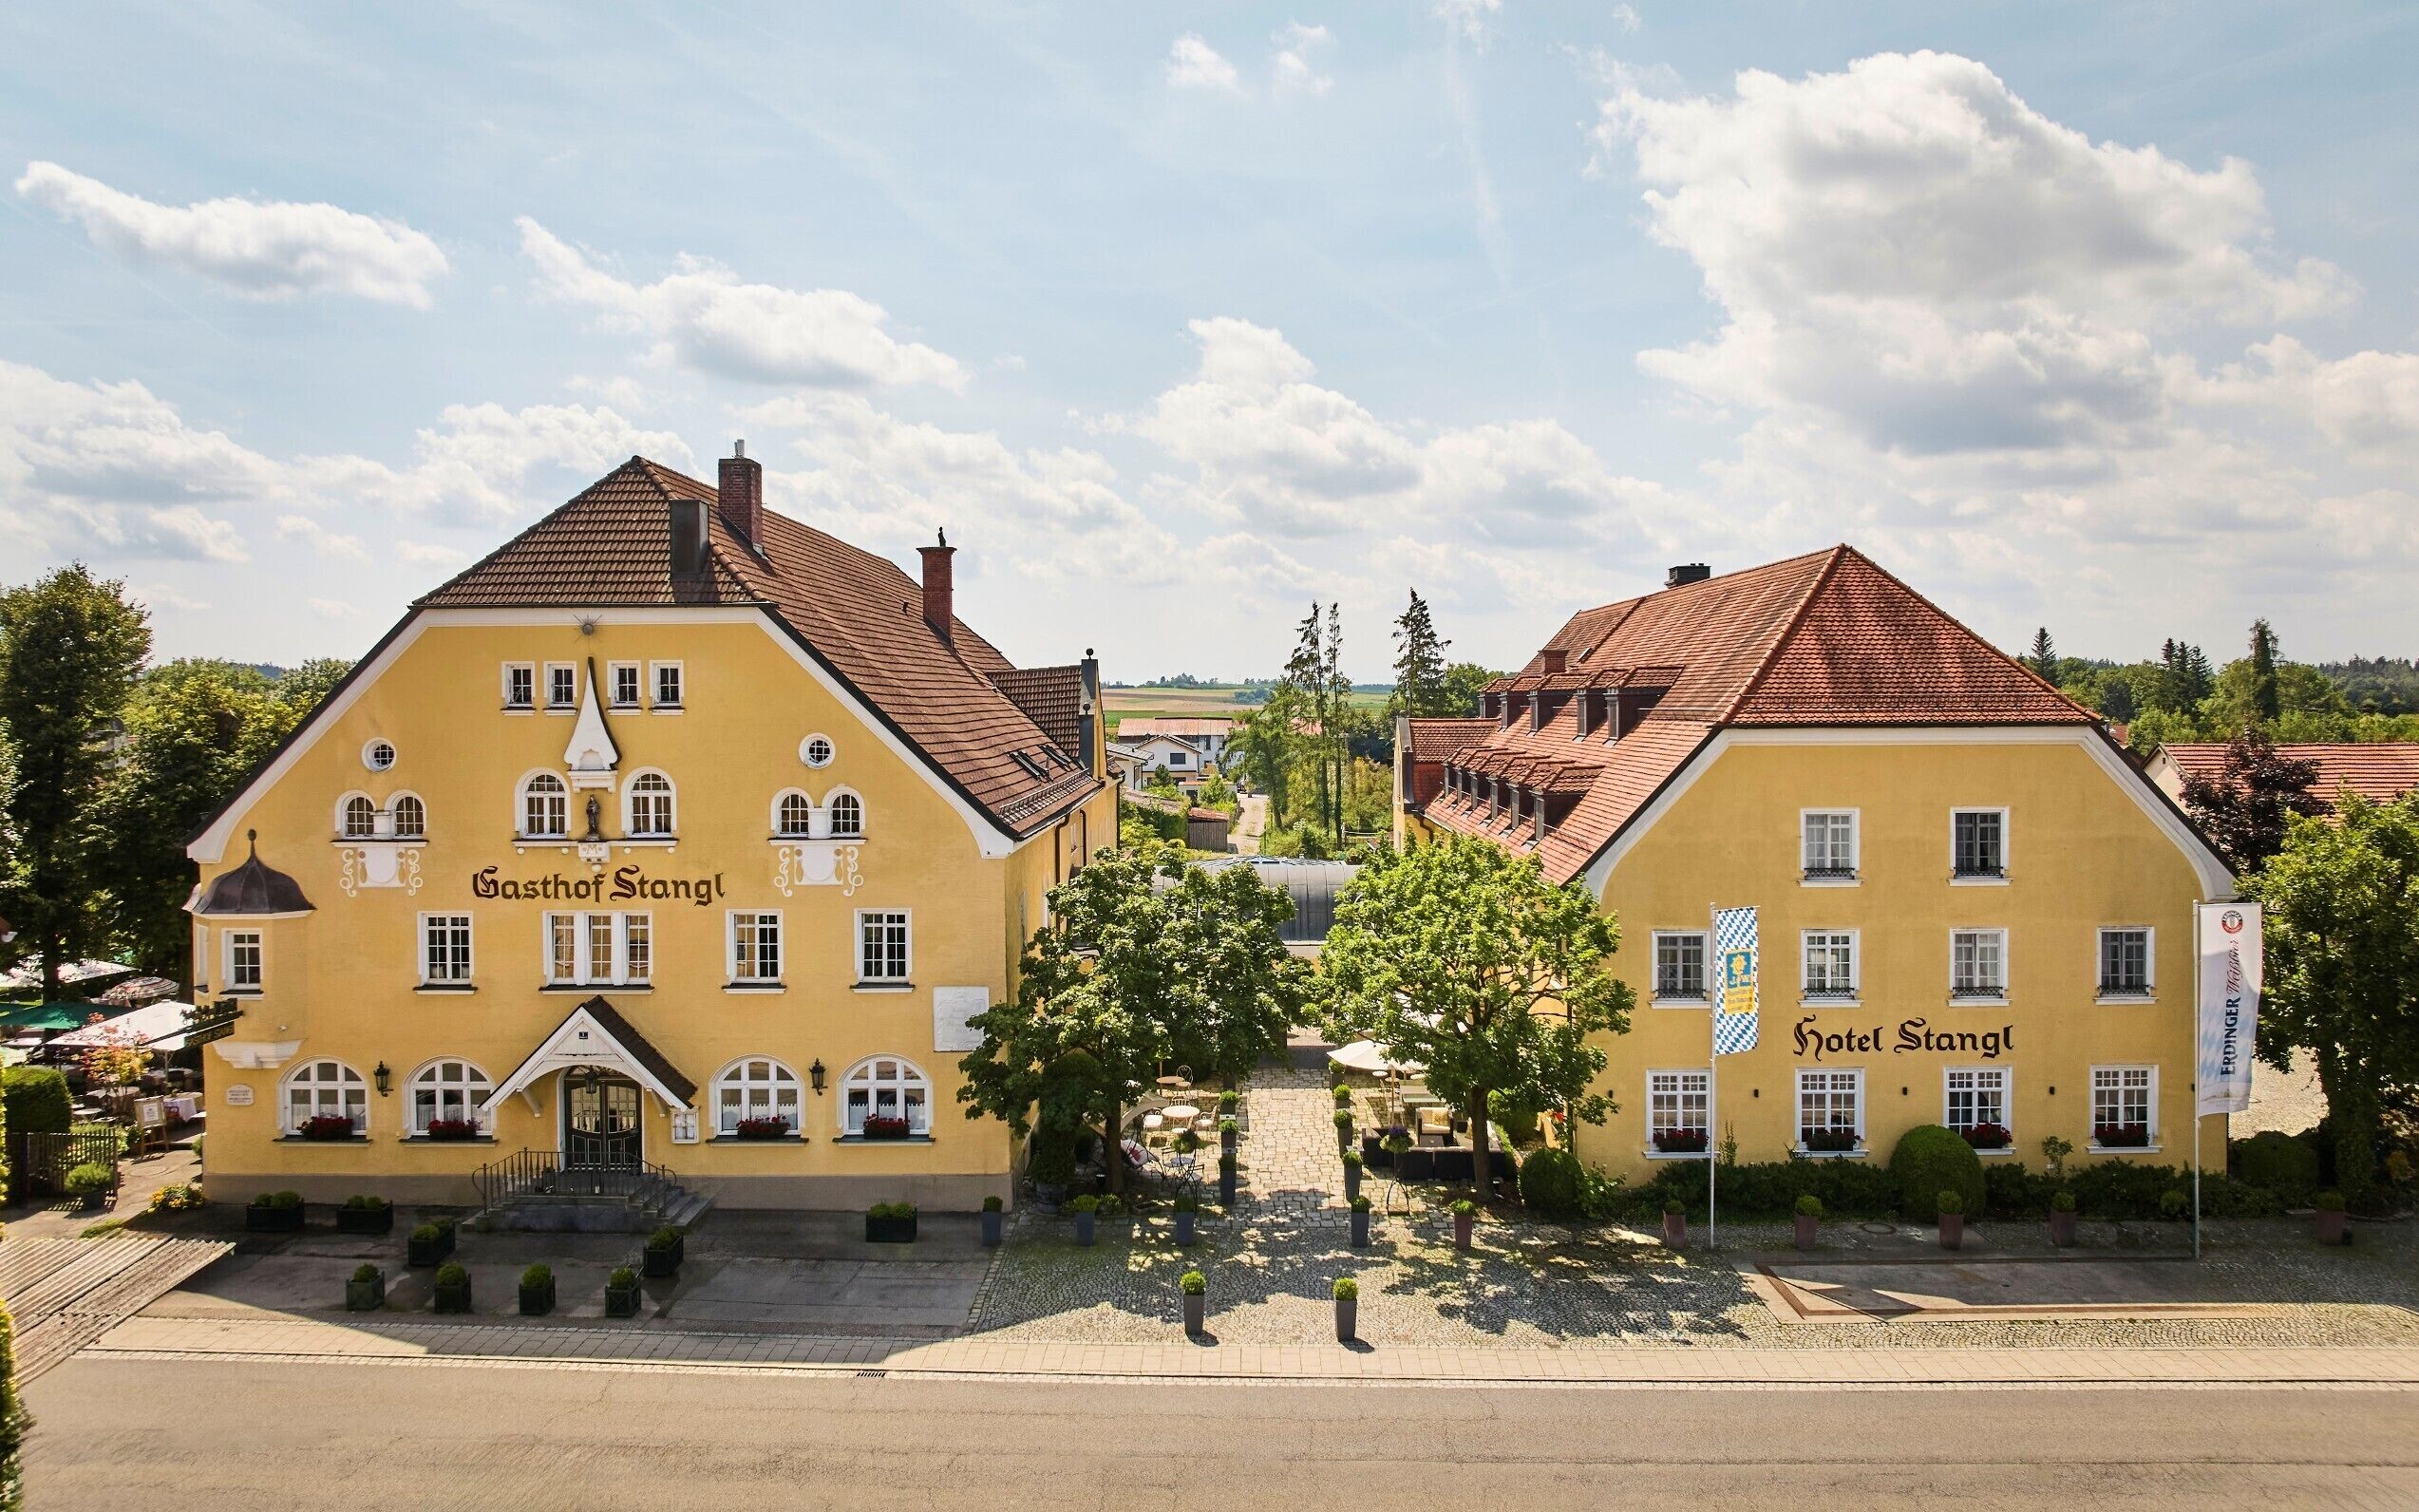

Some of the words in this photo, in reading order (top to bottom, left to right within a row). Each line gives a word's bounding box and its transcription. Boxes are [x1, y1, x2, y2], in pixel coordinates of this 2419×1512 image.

[473, 865, 607, 903] Gasthof
[610, 864, 725, 907] Stangl
[1793, 1013, 1883, 1062] Hotel
[1893, 1017, 2013, 1059] Stangl
[2221, 996, 2241, 1076] ERDINGER
